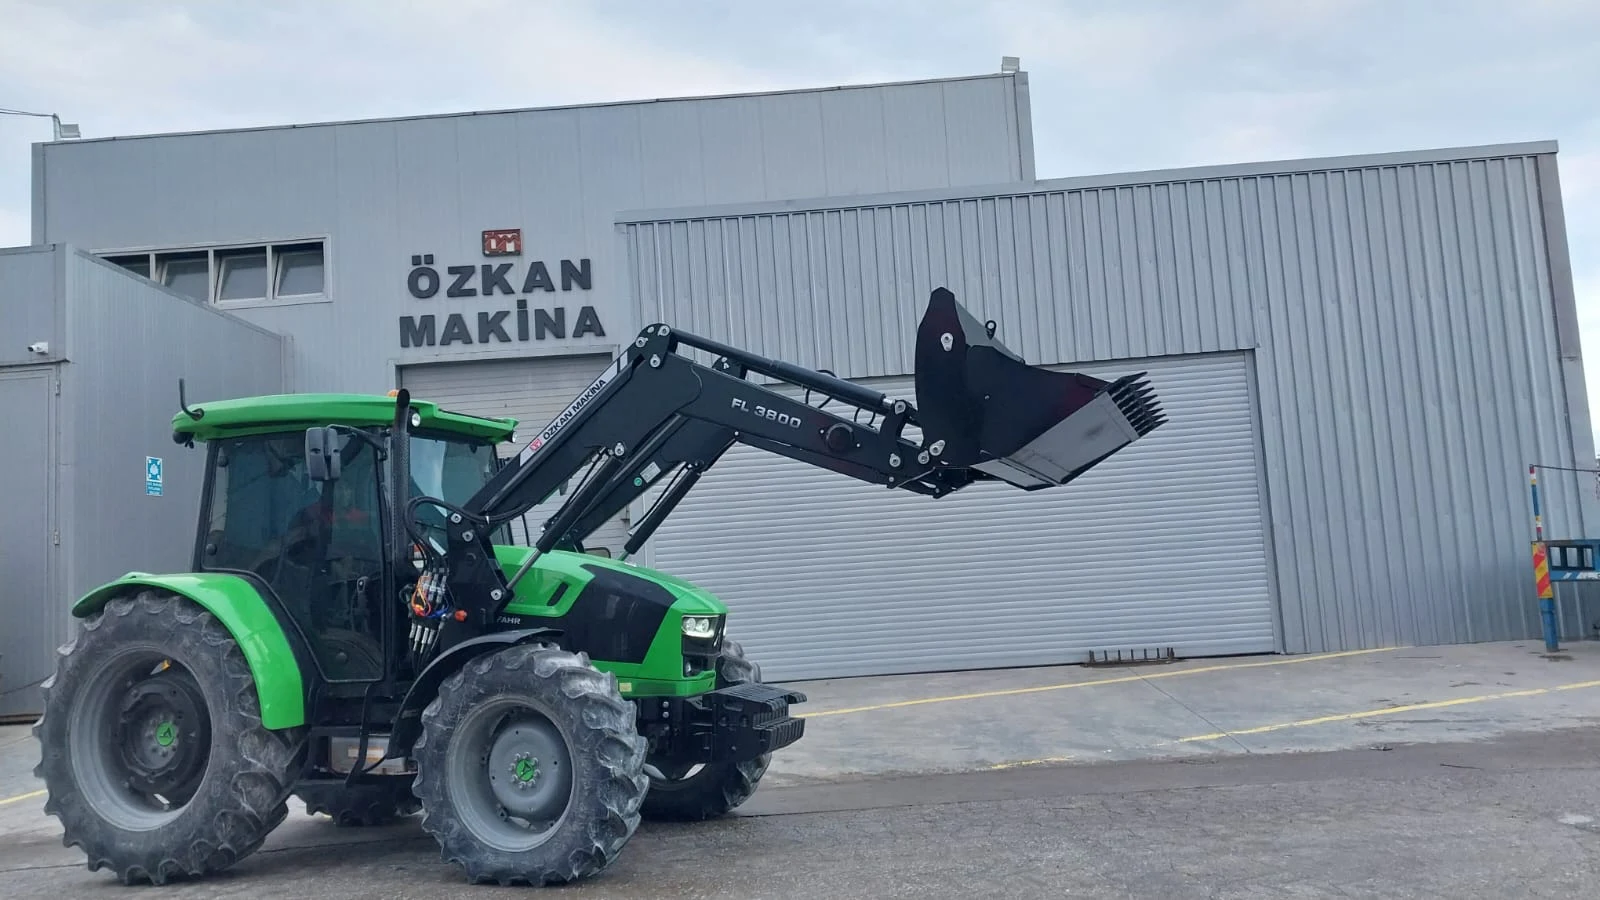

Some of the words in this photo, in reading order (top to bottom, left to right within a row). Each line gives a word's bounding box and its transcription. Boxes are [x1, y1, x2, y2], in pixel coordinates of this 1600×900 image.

[407, 254, 592, 298] ÖZKAN
[399, 299, 606, 348] MAKİNA
[731, 398, 749, 412] FL
[754, 405, 802, 429] 3800
